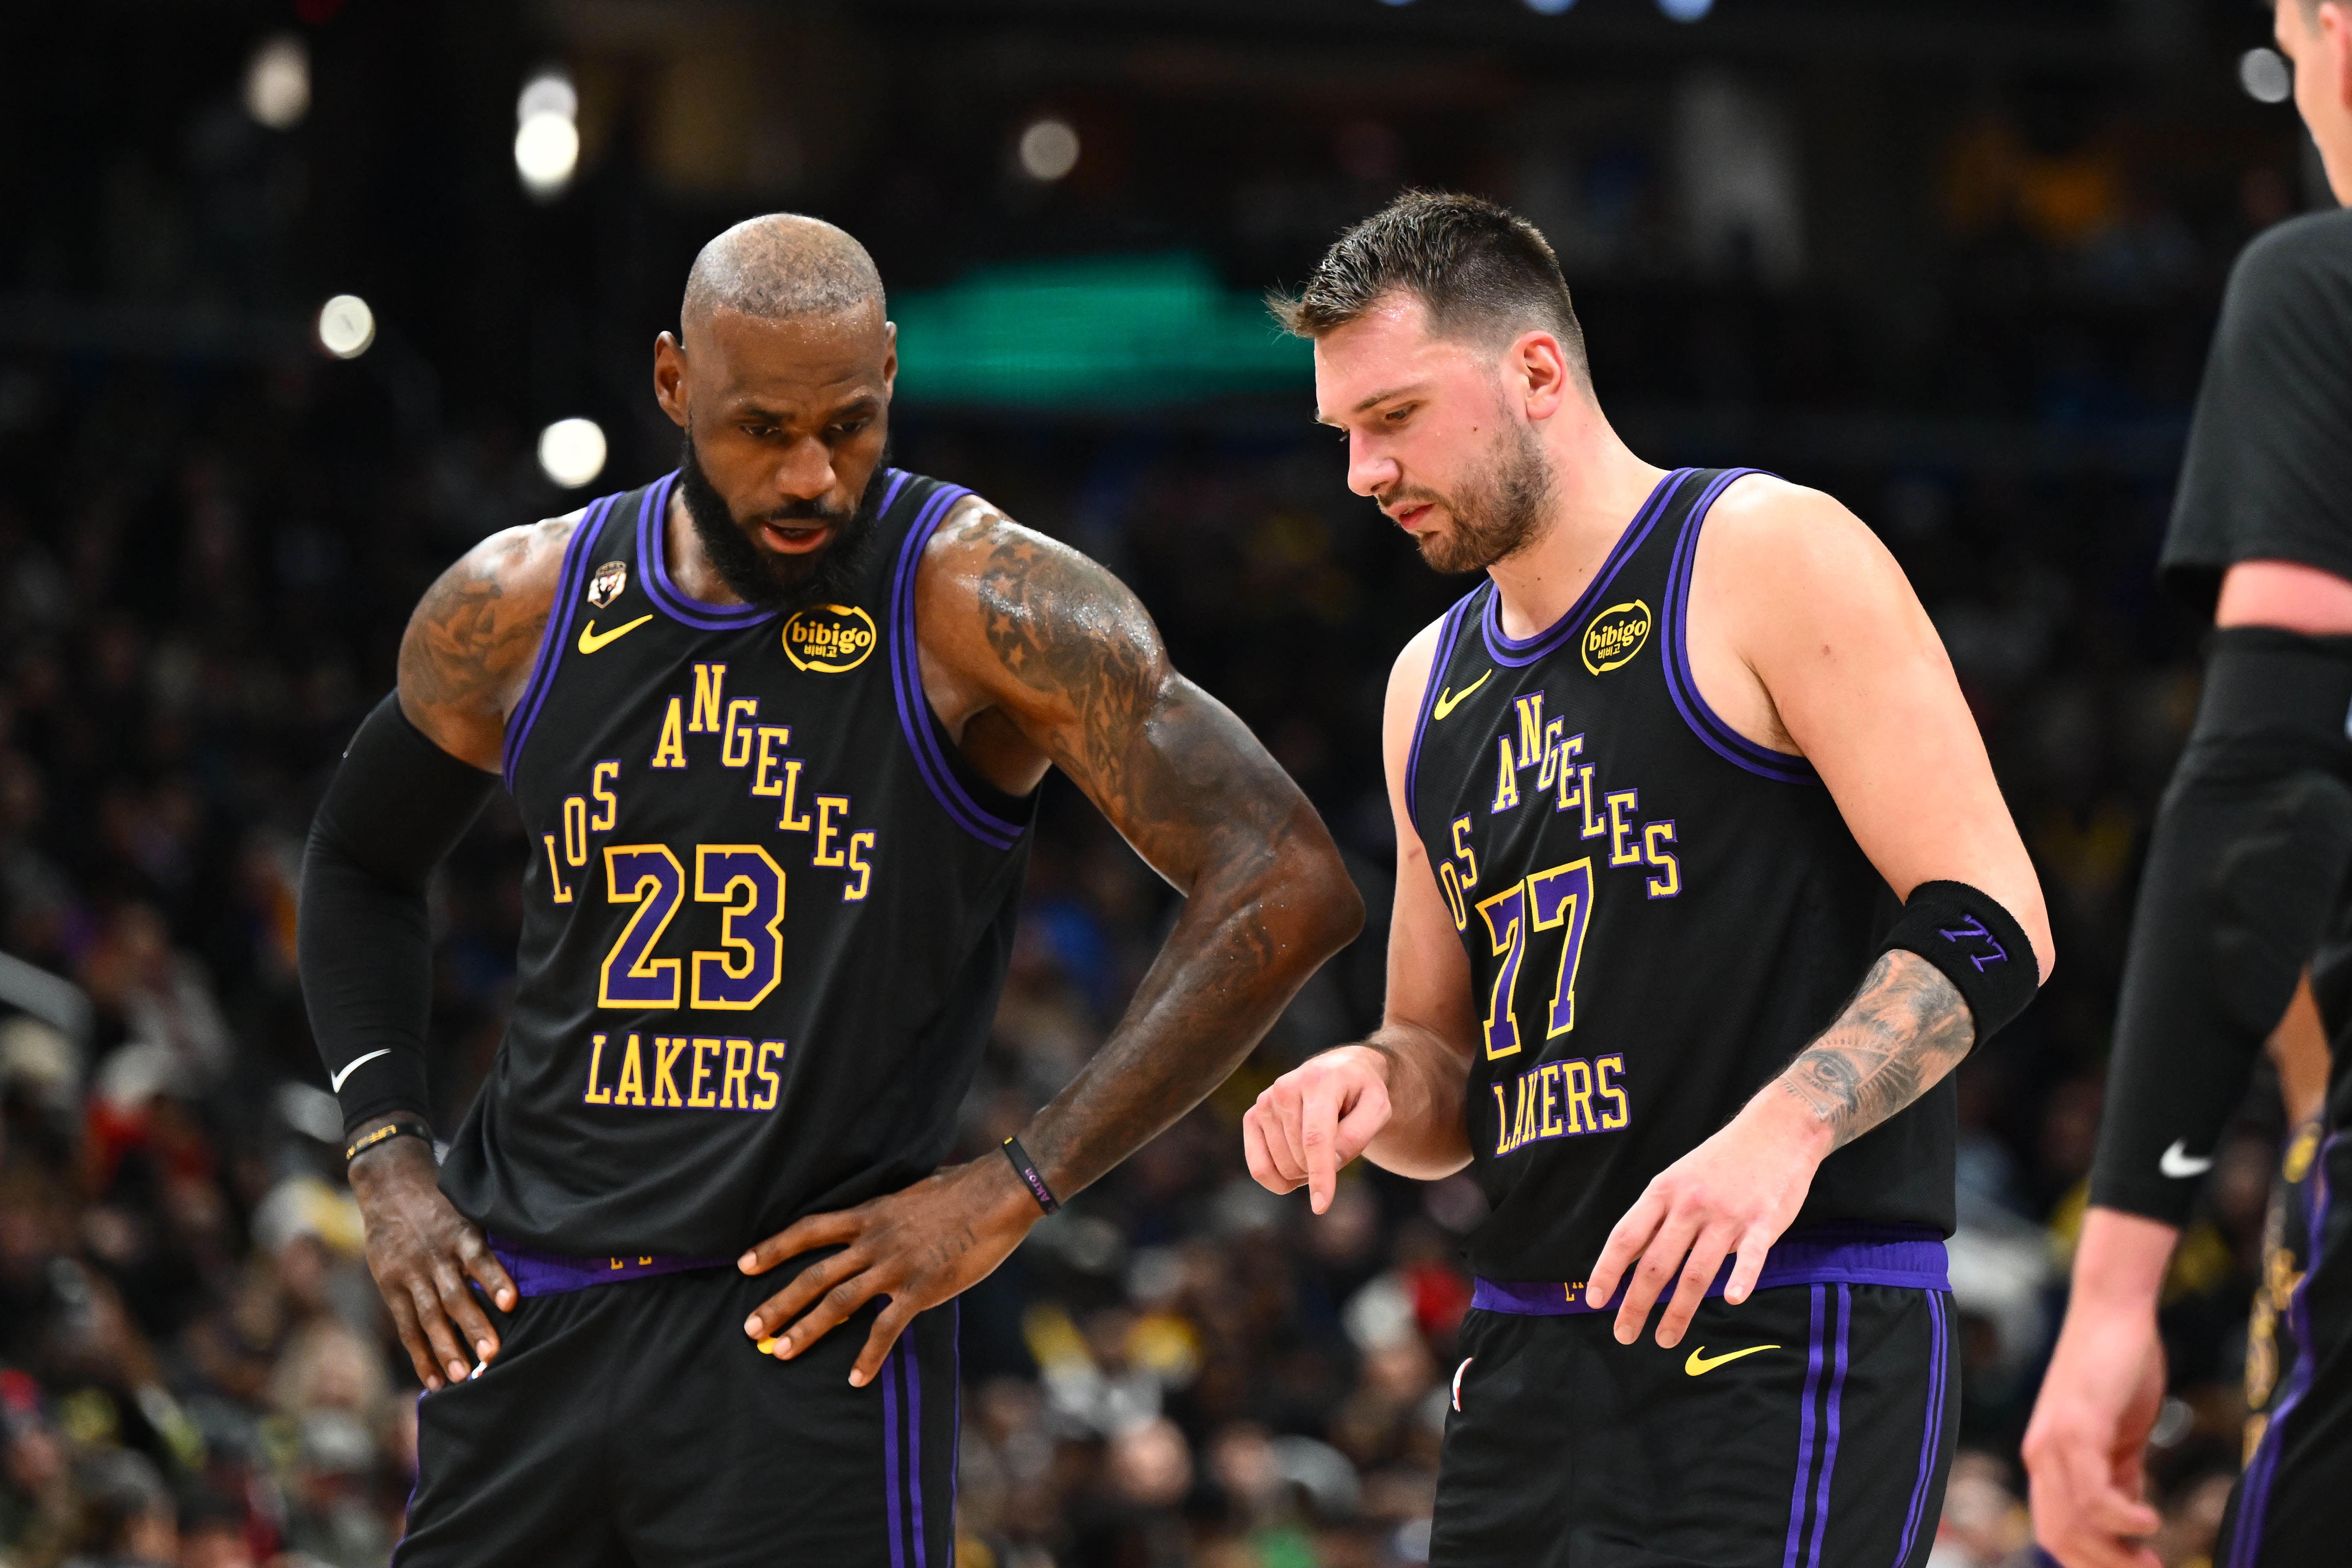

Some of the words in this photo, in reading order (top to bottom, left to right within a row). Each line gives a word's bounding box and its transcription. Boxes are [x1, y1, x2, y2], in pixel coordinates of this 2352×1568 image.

[792, 620, 871, 654] bibigo
[803, 644, 837, 658] 비비고
[1589, 619, 1647, 651] bibigo
[1598, 643, 1620, 659] 비비고
[542, 758, 622, 904] LOS
[650, 661, 877, 903] ANGELES
[1438, 812, 1480, 933] OS
[1491, 690, 1682, 900] ANGELES
[597, 844, 787, 1011] 23
[1475, 856, 1594, 1061] 77
[1938, 913, 2008, 972] 77
[583, 1031, 787, 1112] LAKERS
[1491, 1052, 1632, 1159] LAKERS
